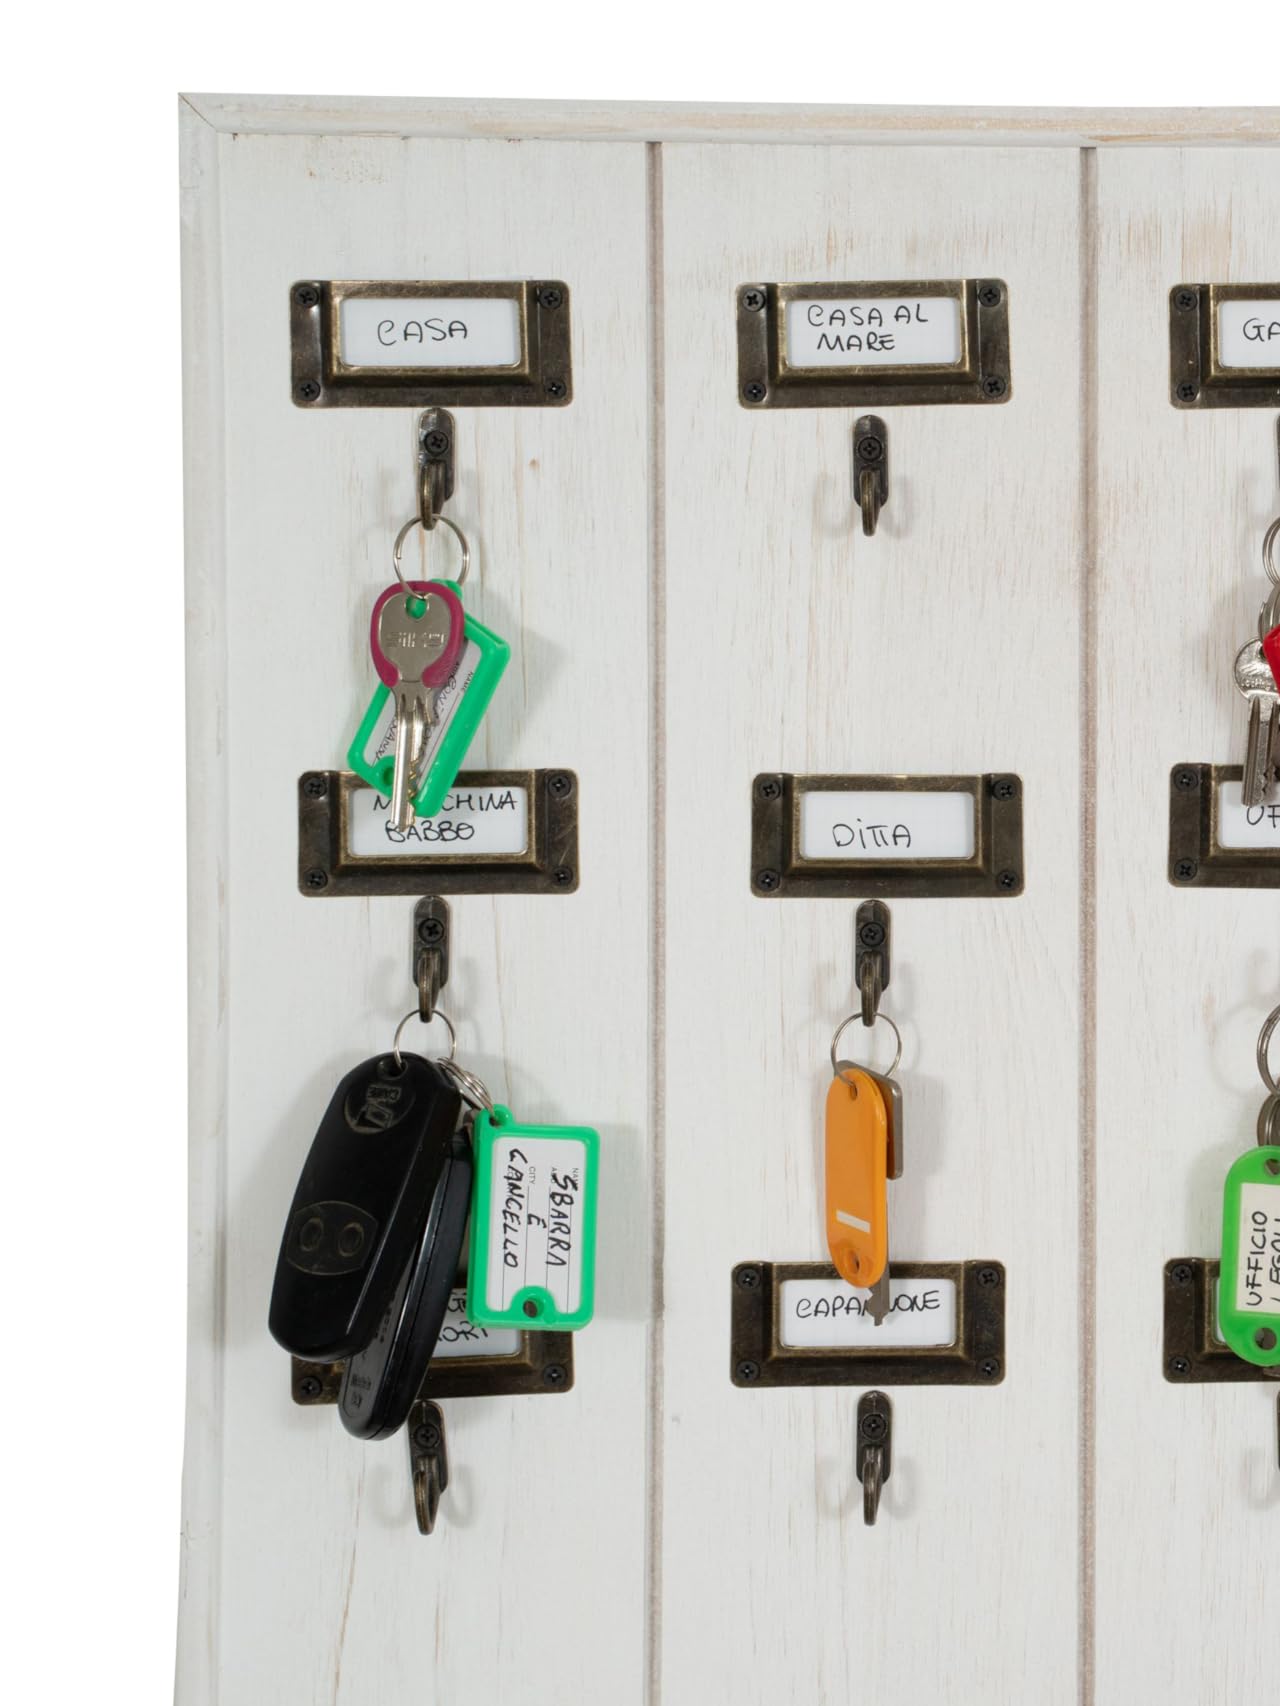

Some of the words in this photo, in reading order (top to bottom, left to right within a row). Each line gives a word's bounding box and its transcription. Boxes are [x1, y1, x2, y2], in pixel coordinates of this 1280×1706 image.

[807, 304, 883, 327] CASA
[894, 303, 928, 324] AL
[377, 318, 468, 346] CASA
[817, 331, 895, 352] MARE
[373, 790, 518, 811] MCHINA
[385, 820, 475, 843] BABBO
[528, 1166, 536, 1184] CITY
[503, 1148, 529, 1269] CANCELLO
[549, 1171, 578, 1267] SBARRA
[1246, 1211, 1267, 1306] UFFICIO
[796, 1290, 940, 1319] CAPAONE
